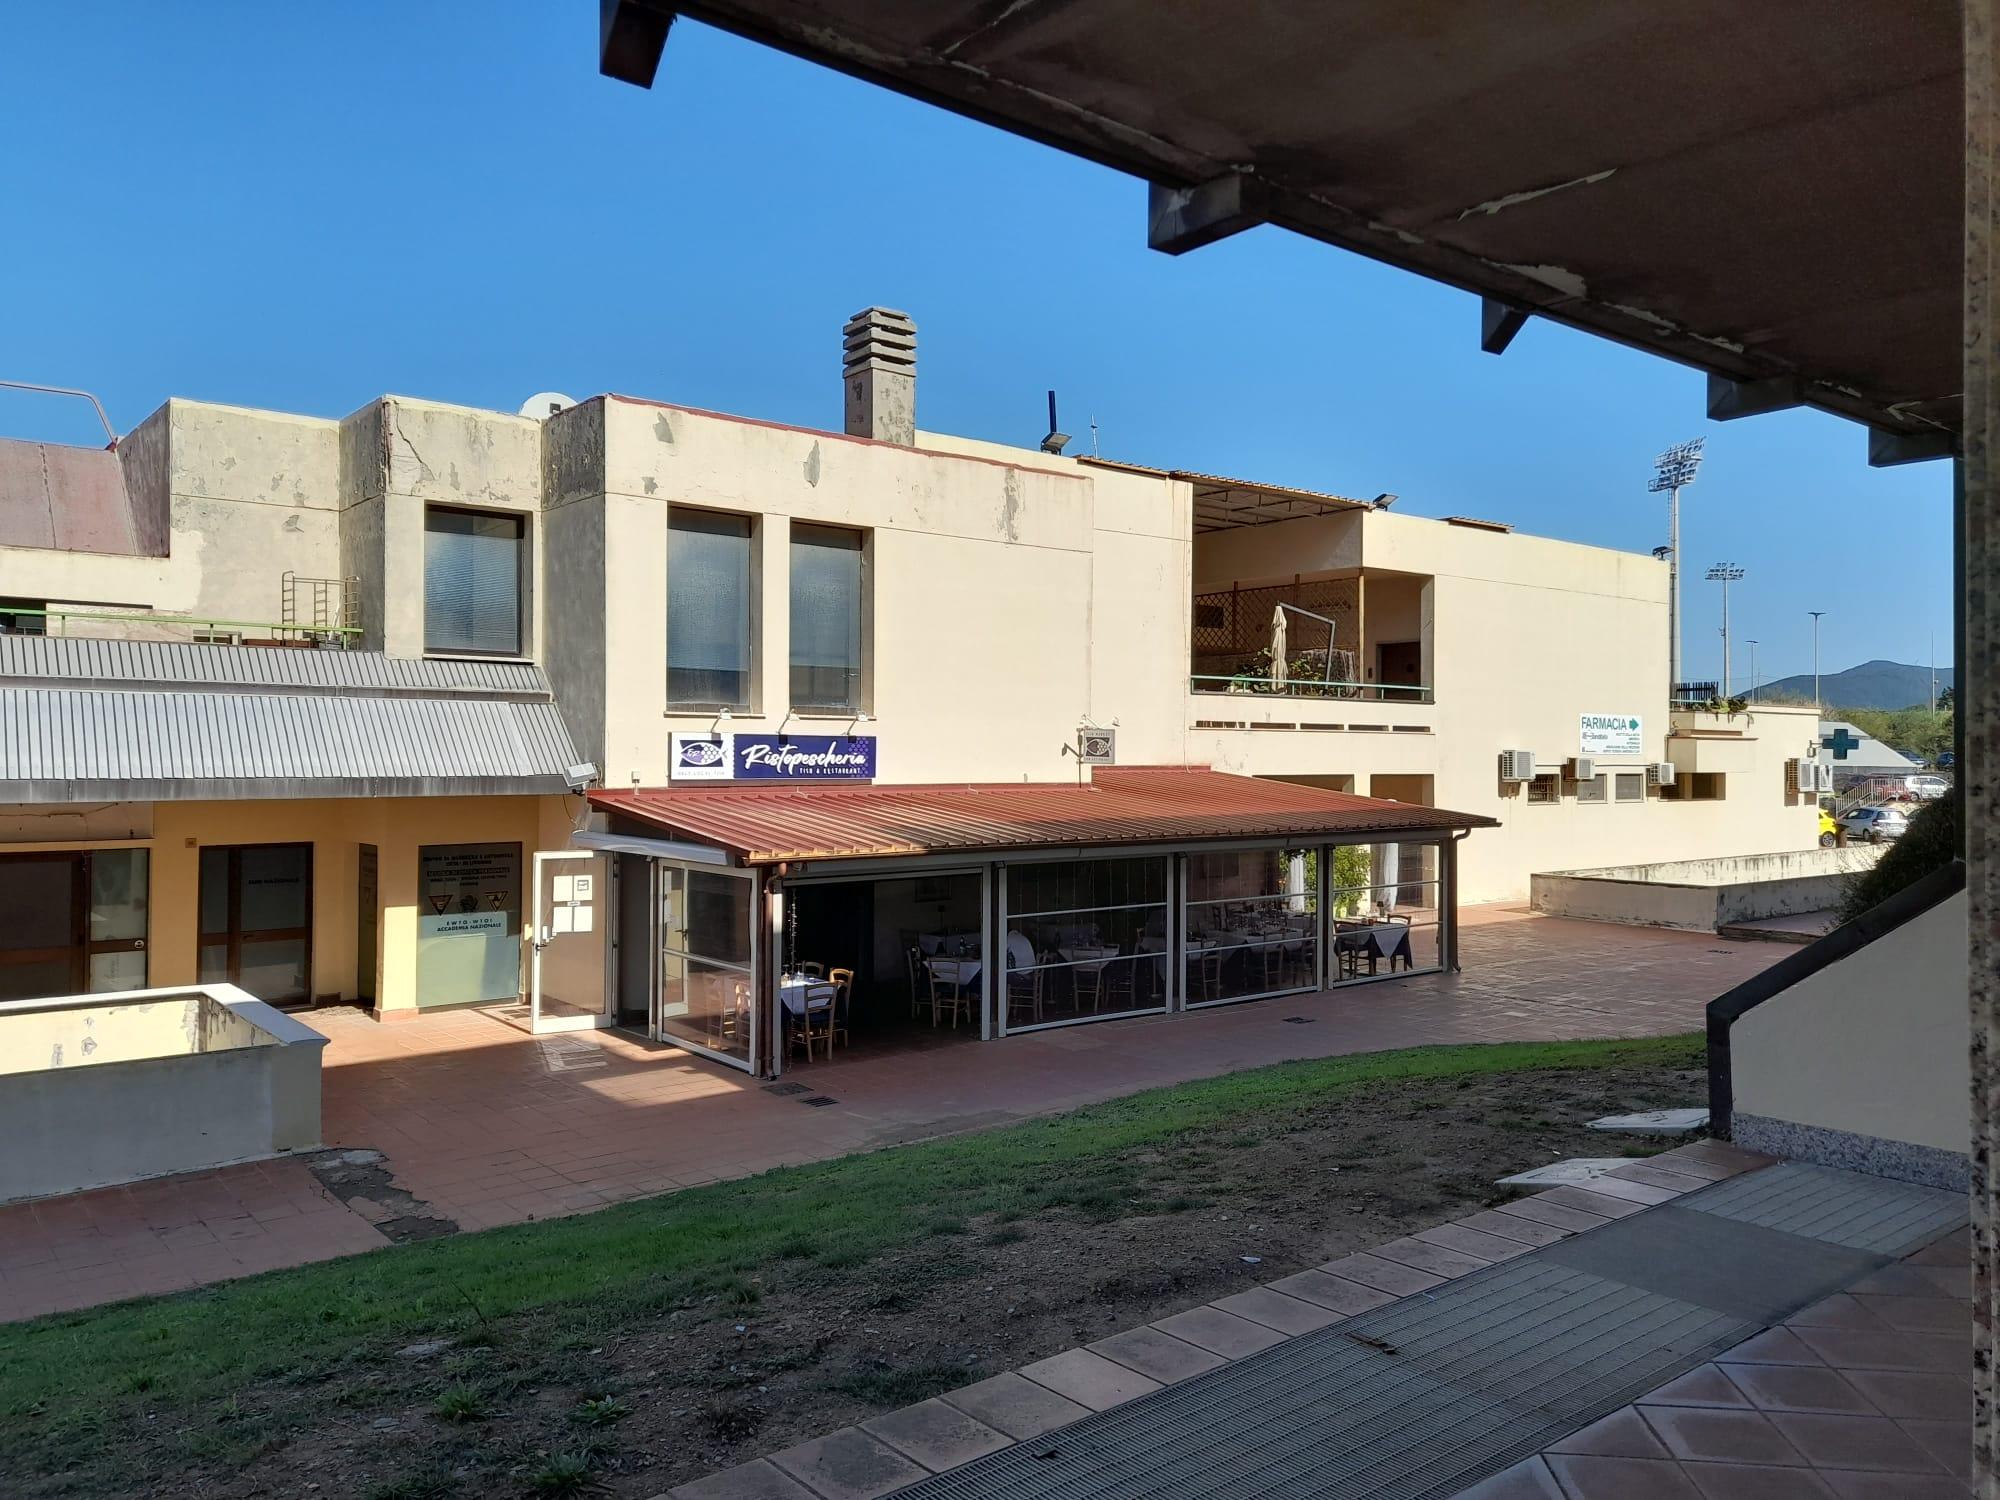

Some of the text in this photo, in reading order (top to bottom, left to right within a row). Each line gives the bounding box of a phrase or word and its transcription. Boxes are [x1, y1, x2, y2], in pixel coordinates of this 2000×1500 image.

[1581, 716, 1627, 730] FARMACIA
[740, 741, 866, 776] Ristopescheria
[469, 922, 502, 930] NAZIONALE
